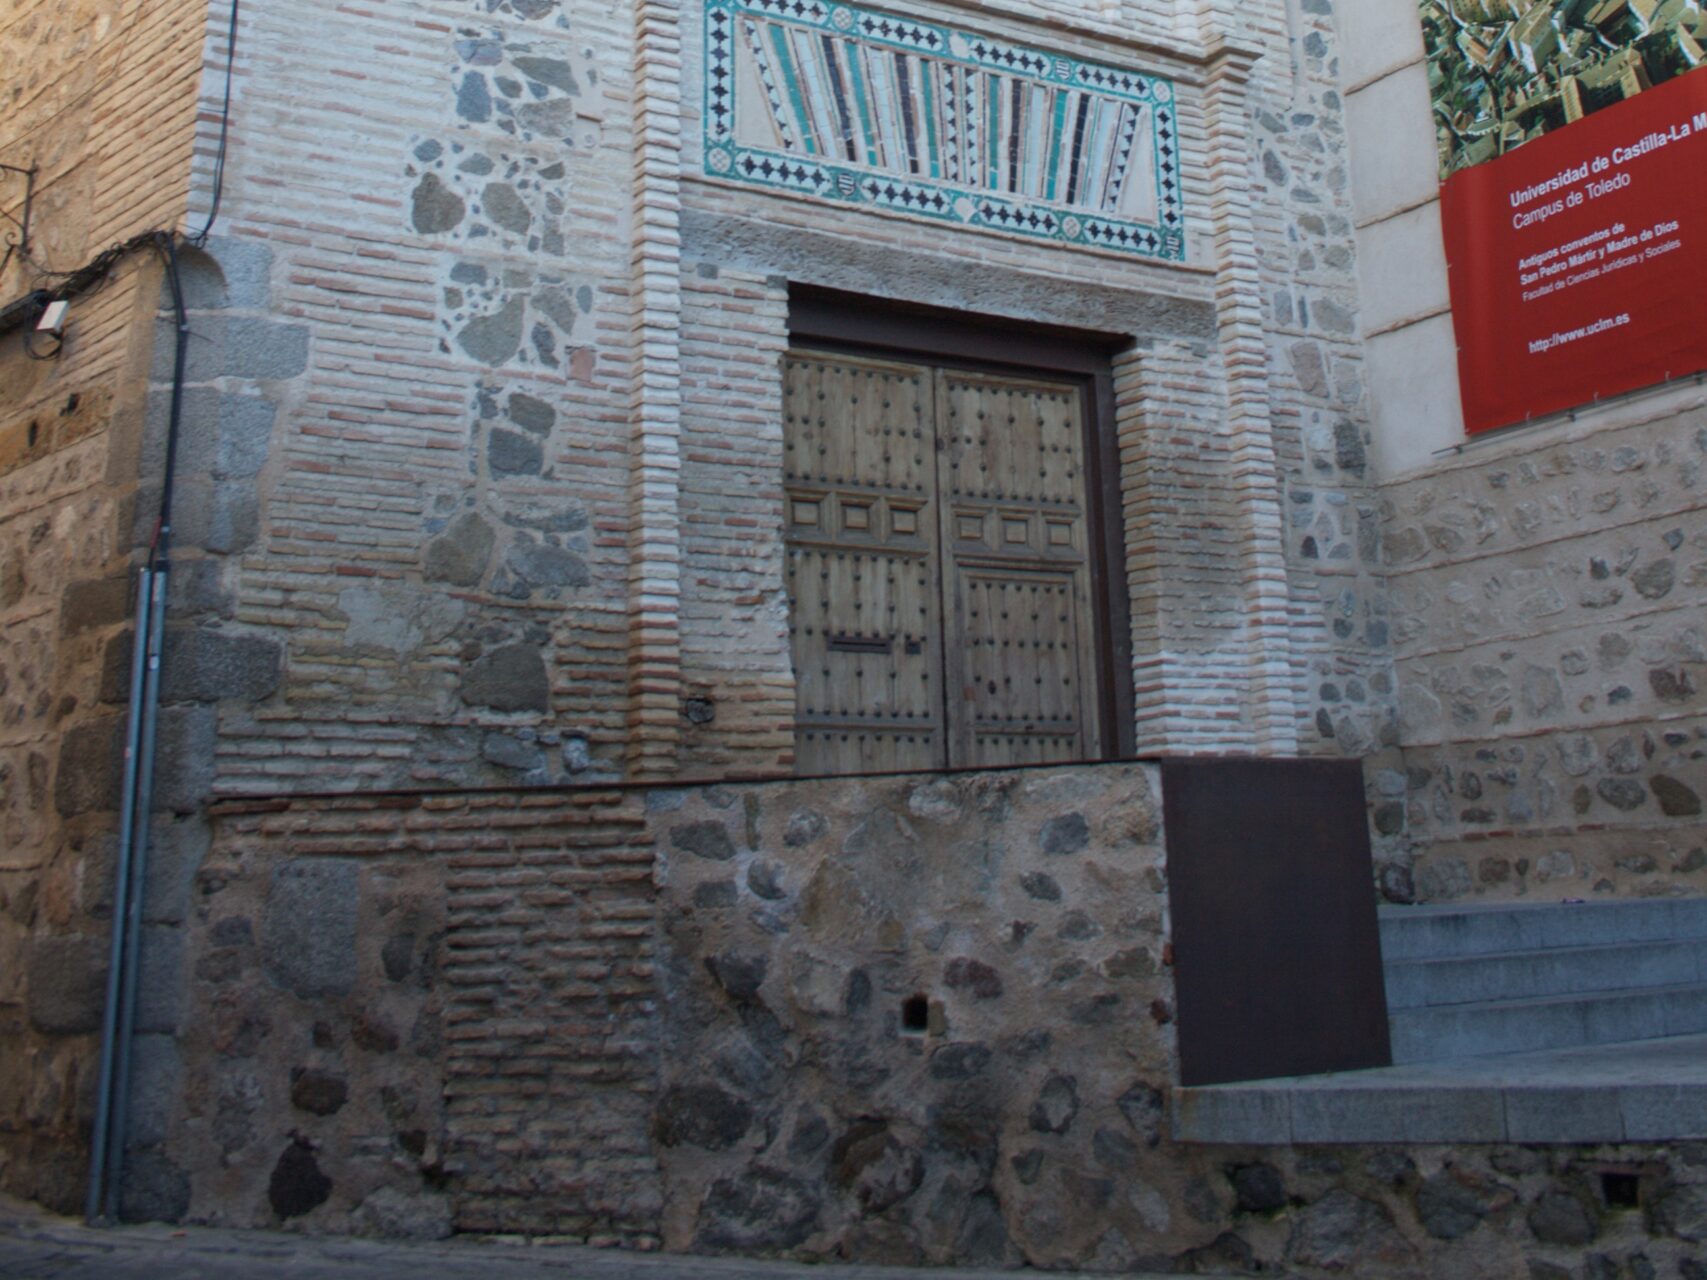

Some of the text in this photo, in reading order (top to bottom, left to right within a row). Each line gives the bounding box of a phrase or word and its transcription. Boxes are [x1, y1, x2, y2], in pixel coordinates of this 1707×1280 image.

[1510, 162, 1589, 208] Universidad
[1591, 156, 1609, 174] de
[1612, 122, 1690, 164] Castilla-La
[1513, 172, 1631, 230] Campus de Toledo
[1519, 223, 1625, 270] Antiguos conventos de
[1520, 220, 1679, 285] San Pedro Mártir y Madre de Dios
[1522, 283, 1554, 302] Facultad
[1554, 280, 1566, 290] de
[1566, 266, 1600, 286] Ciencias
[1645, 239, 1681, 257] Sociales
[1529, 313, 1630, 353] http://www.uclm.es
